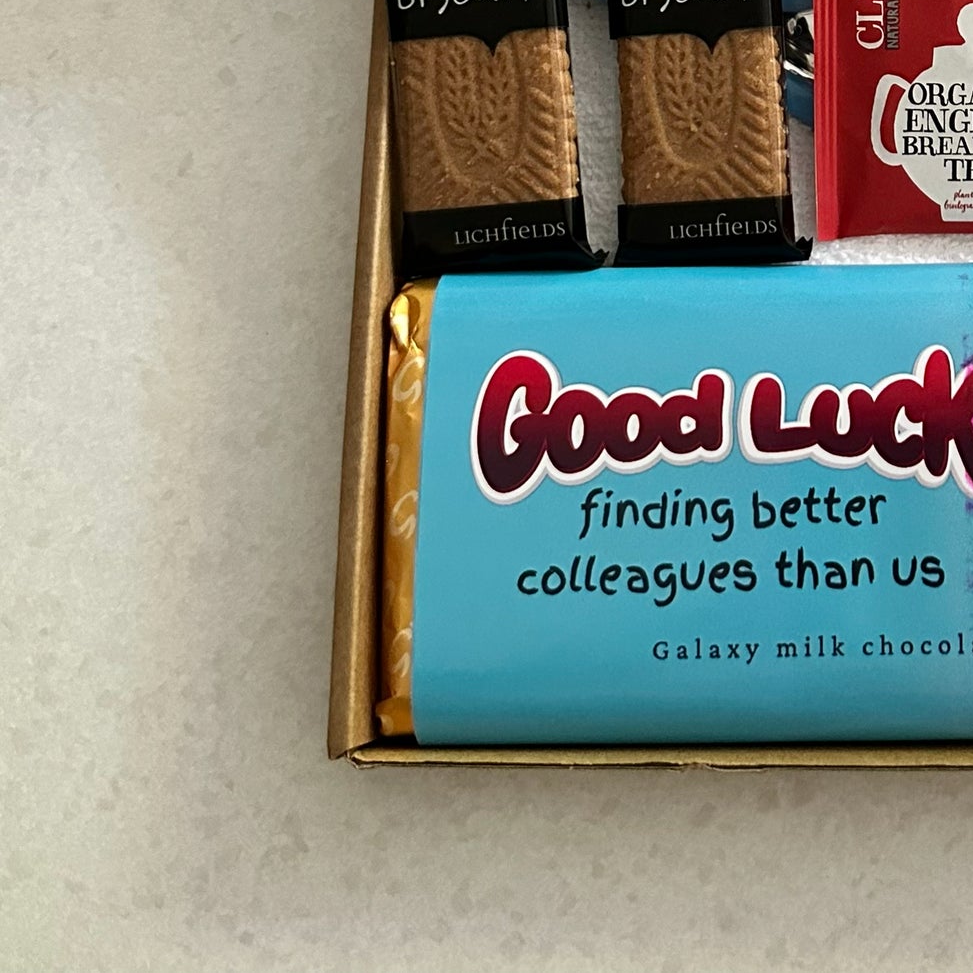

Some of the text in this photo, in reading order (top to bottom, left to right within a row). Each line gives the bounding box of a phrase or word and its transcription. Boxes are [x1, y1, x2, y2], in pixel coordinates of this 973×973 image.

[579, 487, 887, 542] finding better
[517, 547, 945, 607] colleagues than us
[652, 639, 760, 665] Galaxy
[775, 634, 846, 658] milk
